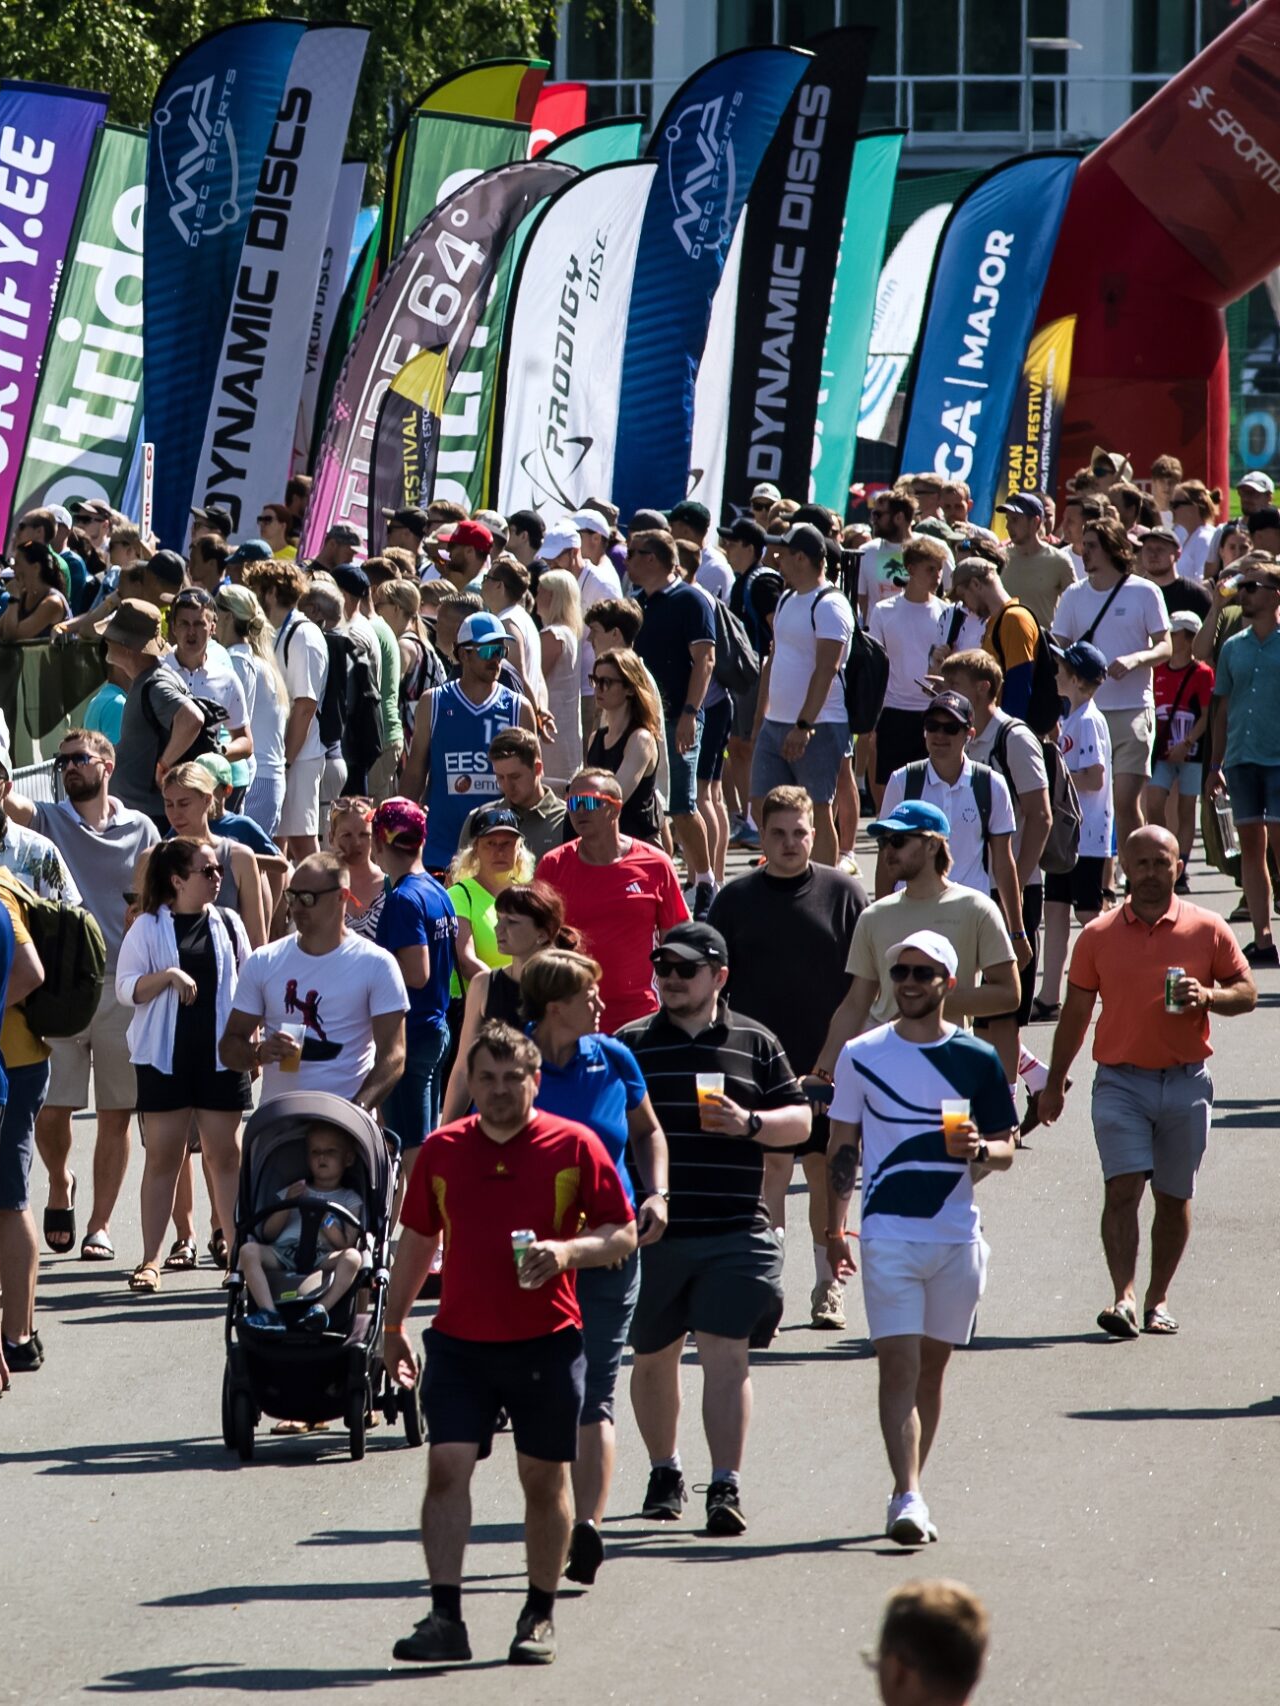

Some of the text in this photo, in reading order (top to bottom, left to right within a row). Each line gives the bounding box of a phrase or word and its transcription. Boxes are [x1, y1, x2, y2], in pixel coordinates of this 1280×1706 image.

[190, 68, 237, 247] DISC SPORTS
[691, 91, 744, 260] DISC SPORTS
[1208, 109, 1280, 194] SPORTL
[204, 87, 312, 534] DYNAMIC DISCS
[585, 223, 611, 302] DISC
[747, 243, 805, 480] DYNAMIC
[779, 84, 831, 230] DISCS
[958, 230, 1015, 369] MAJOR
[546, 254, 582, 457] PRODIGY
[403, 410, 417, 509] FESTIVAL
[1023, 444, 1039, 490] GOLF
